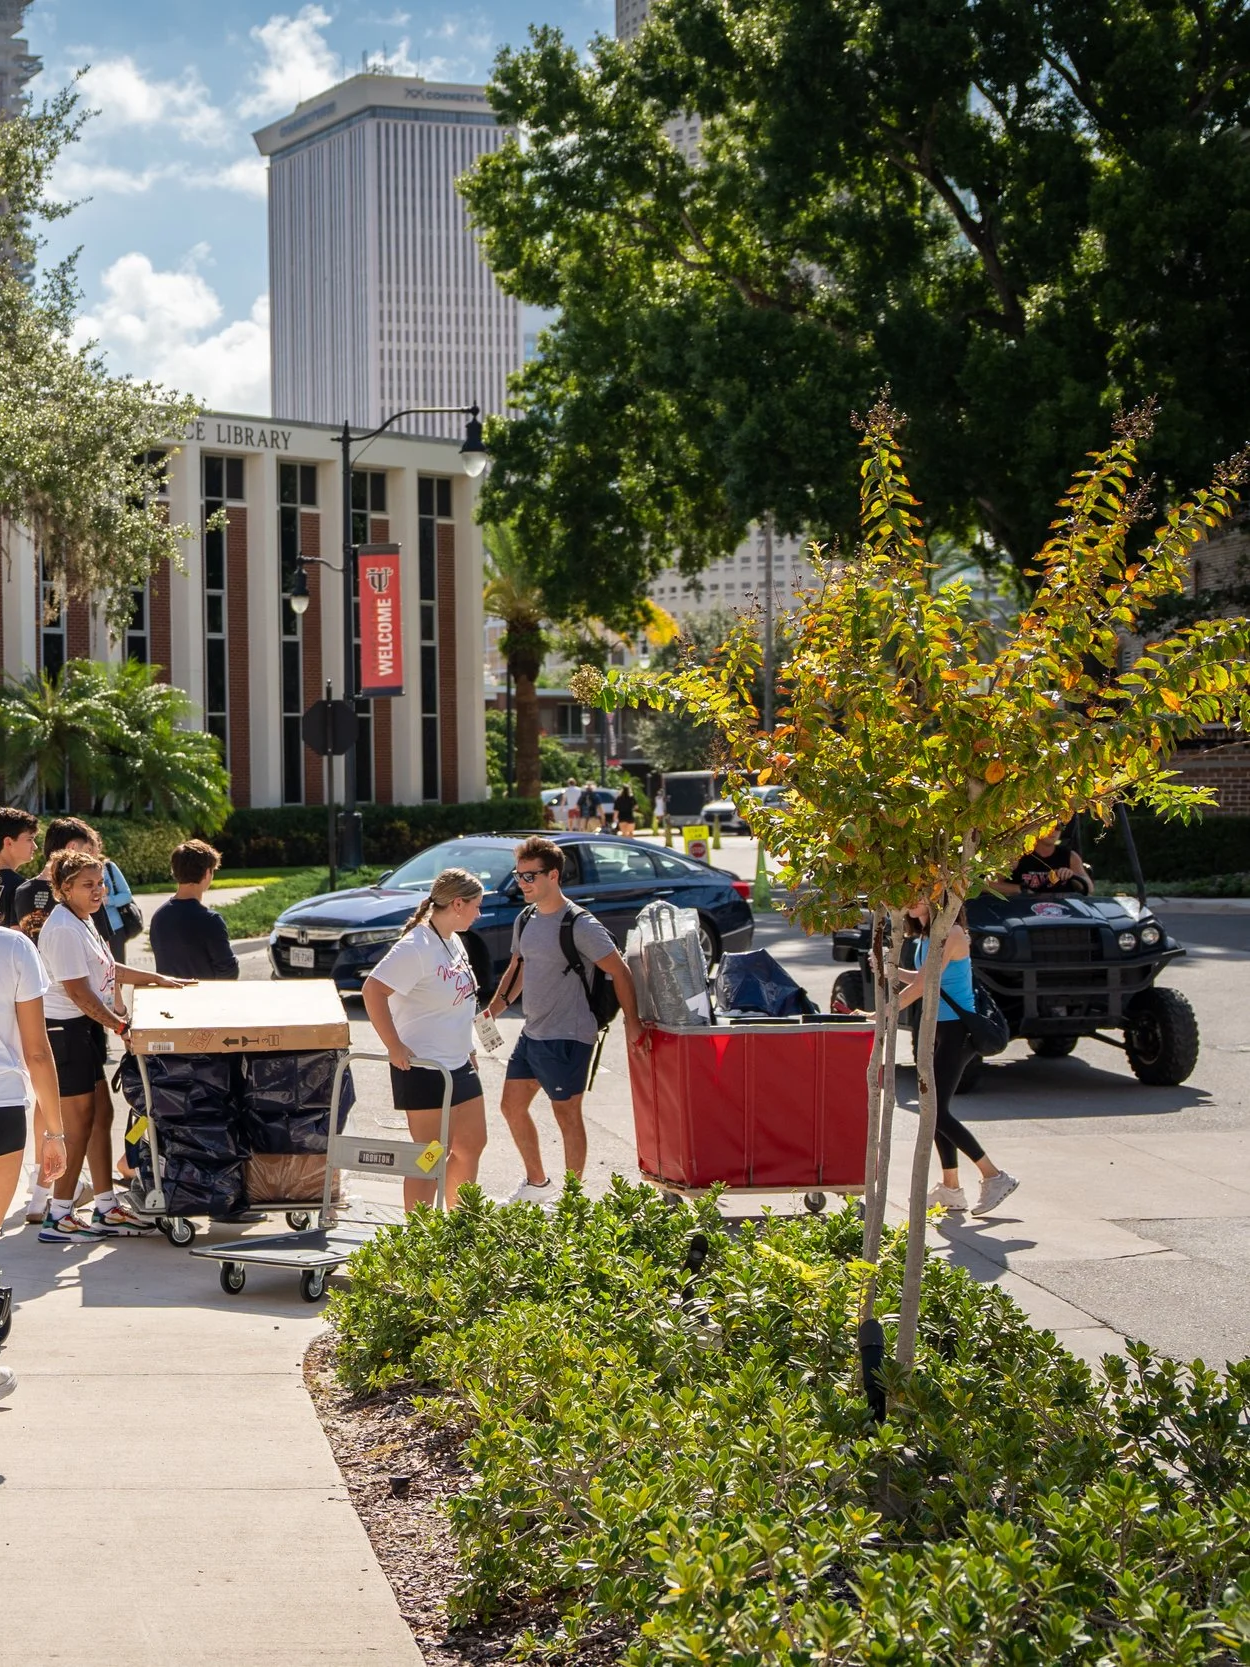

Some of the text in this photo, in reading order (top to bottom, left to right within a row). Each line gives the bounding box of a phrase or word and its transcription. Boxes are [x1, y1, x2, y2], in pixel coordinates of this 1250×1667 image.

[217, 424, 292, 450] LIBRARY
[377, 598, 393, 677] WELCOME
[362, 1153, 390, 1164] IRONTON
